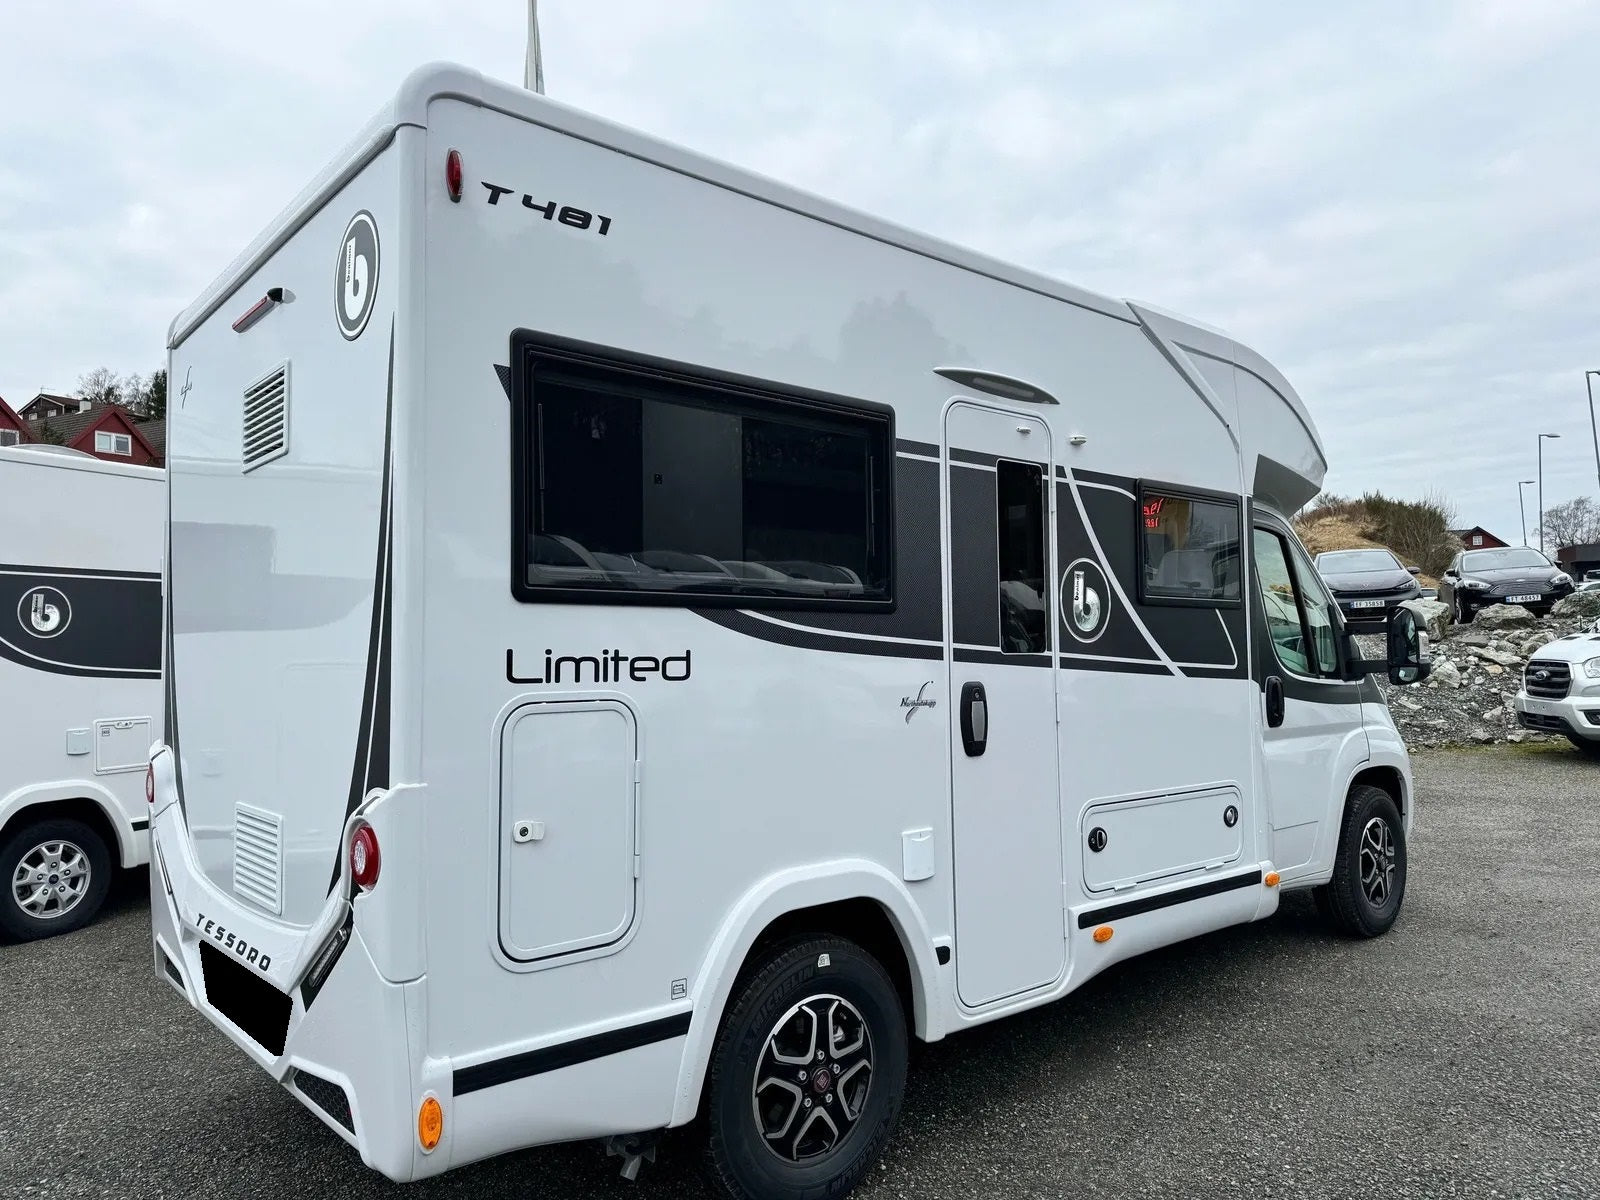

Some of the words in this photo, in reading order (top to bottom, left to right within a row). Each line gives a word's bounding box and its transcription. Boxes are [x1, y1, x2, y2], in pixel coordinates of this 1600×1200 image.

[480, 181, 515, 206] T
[522, 193, 612, 236] 481
[506, 648, 691, 684] Limited
[195, 913, 272, 972] TESSORO
